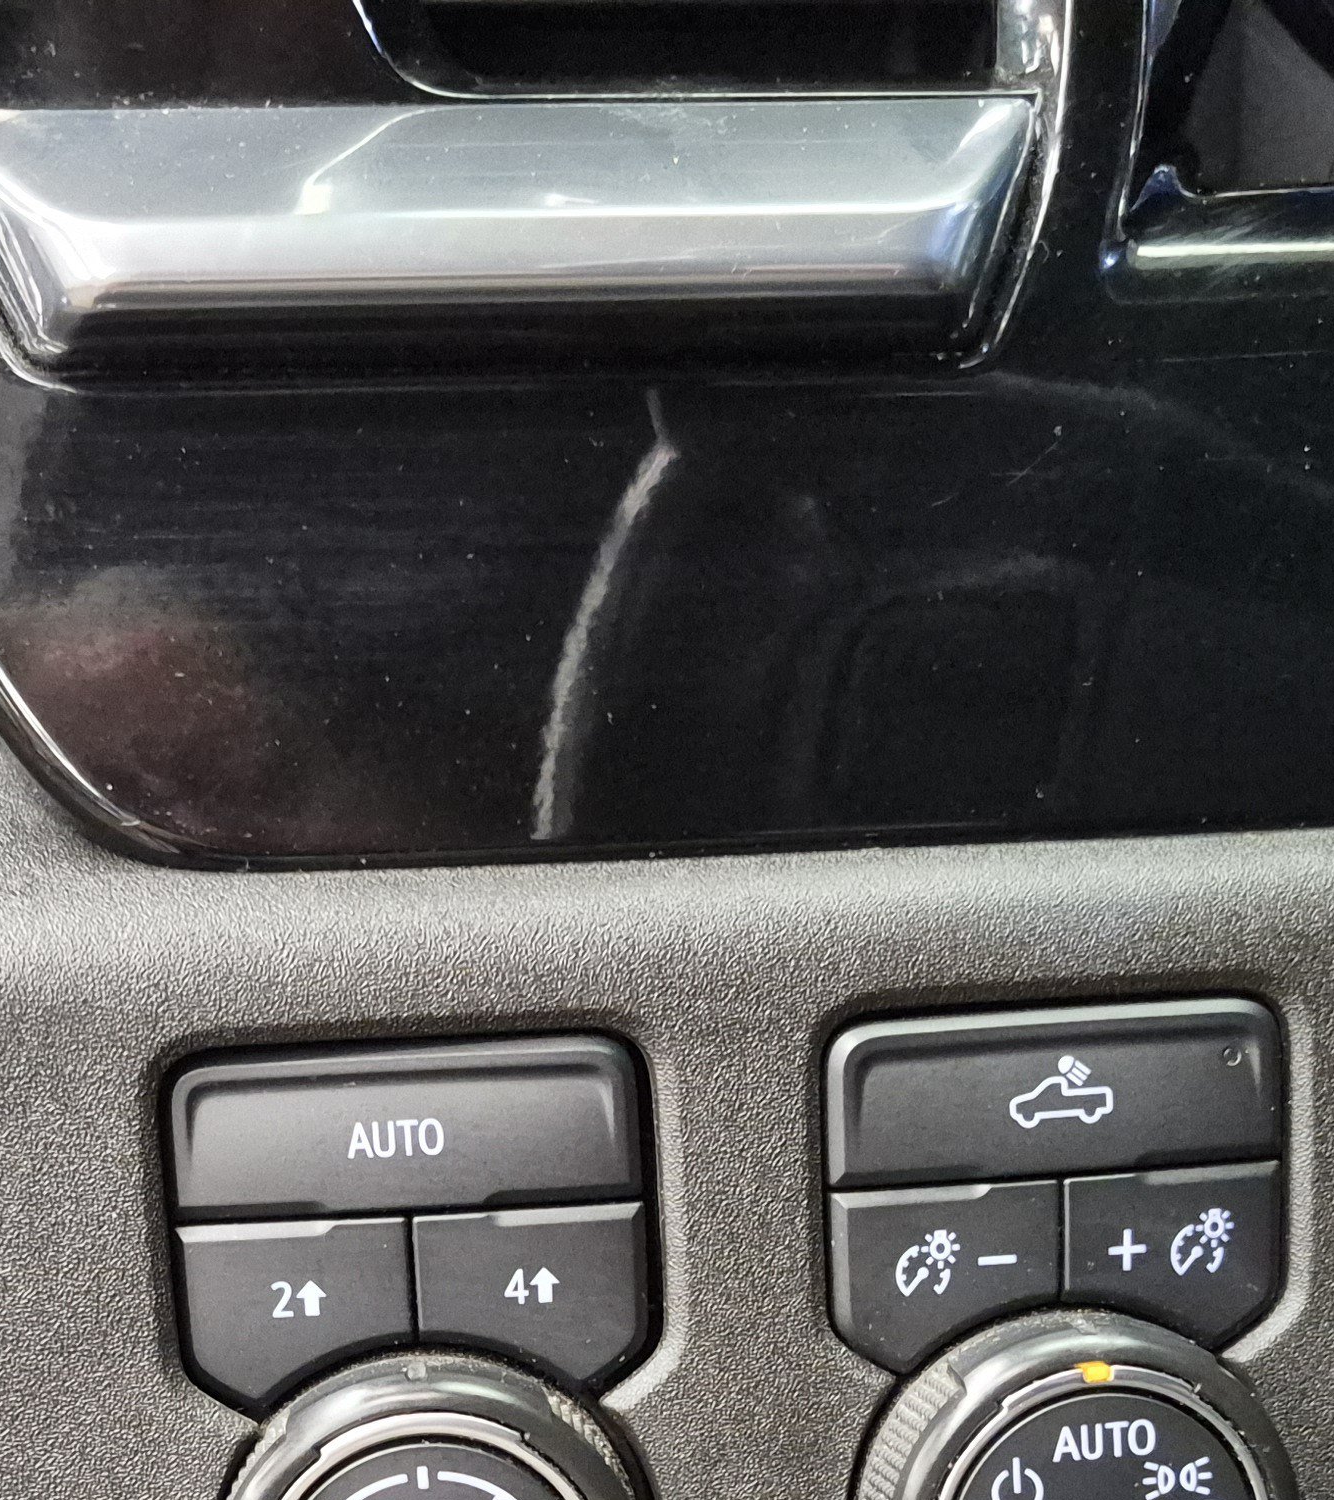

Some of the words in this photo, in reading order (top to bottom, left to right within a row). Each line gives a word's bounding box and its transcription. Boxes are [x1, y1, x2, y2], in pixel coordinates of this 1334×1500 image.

[347, 1117, 445, 1159] AUTO
[269, 1280, 295, 1319] 2
[503, 1268, 530, 1305] 4
[1052, 1418, 1157, 1464] AUTO
